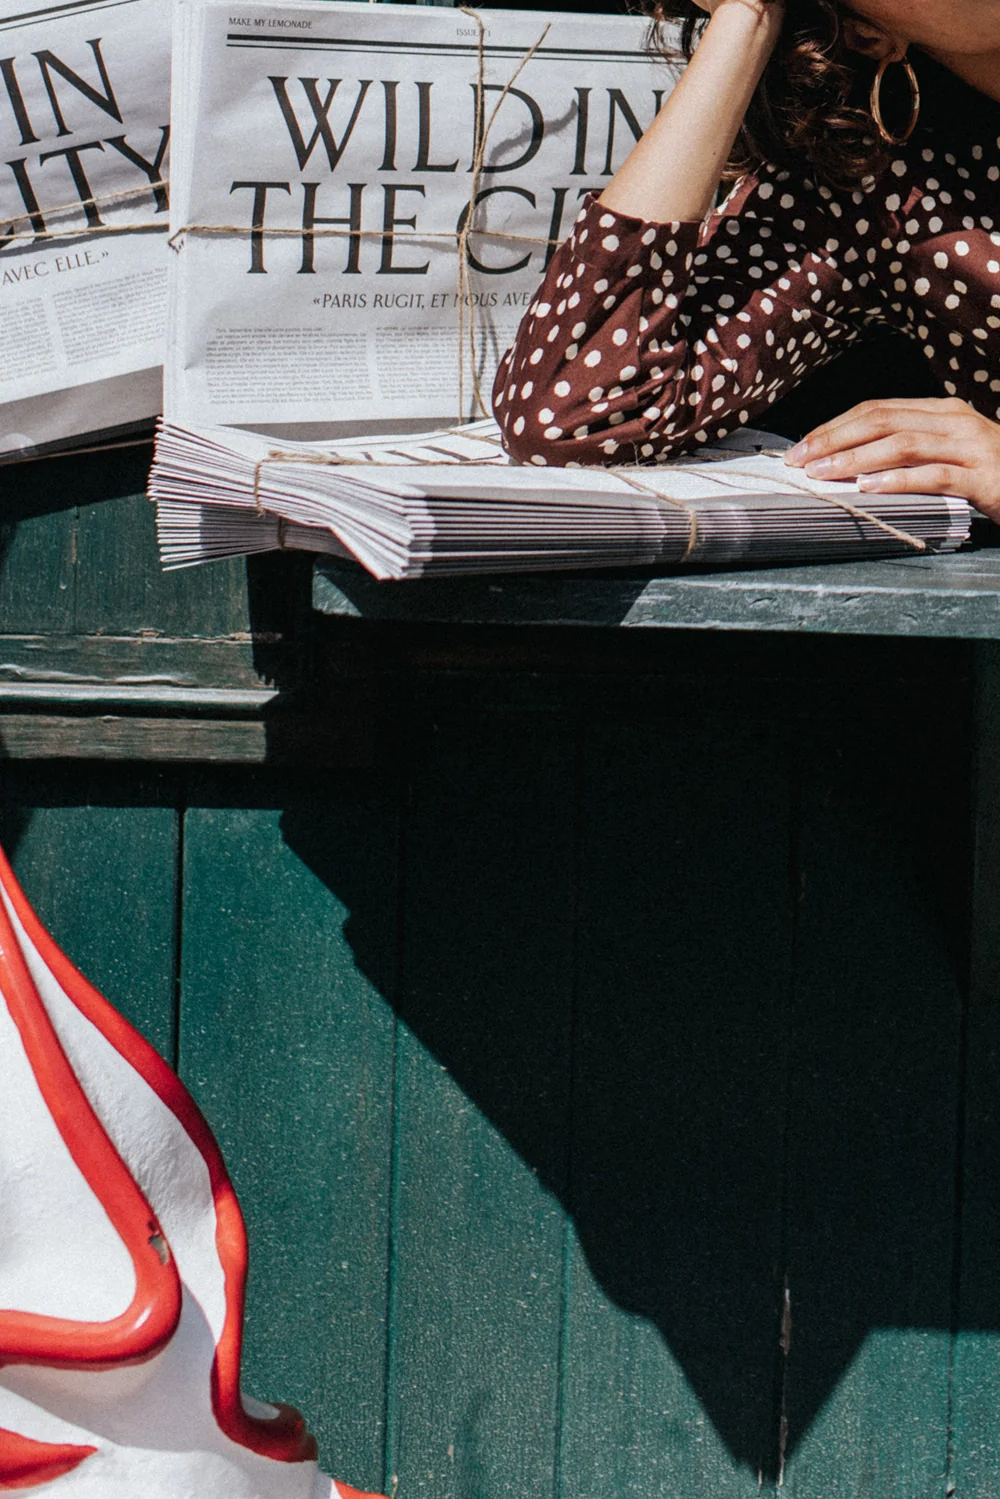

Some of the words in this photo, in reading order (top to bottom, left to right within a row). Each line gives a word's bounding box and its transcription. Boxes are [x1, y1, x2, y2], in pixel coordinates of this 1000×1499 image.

[229, 16, 251, 26] MAKE
[254, 18, 265, 27] MY
[268, 19, 312, 30] LEMONADE
[0, 38, 123, 146] IN
[267, 75, 545, 173] WILD
[0, 124, 170, 249] ITY
[228, 180, 433, 275] THE
[456, 185, 606, 275] CI
[2, 261, 49, 287] AVEC
[55, 250, 109, 274] ELLE.»
[313, 293, 368, 309] «PARIS
[372, 293, 425, 311] RUGIT,
[431, 292, 448, 309] ET
